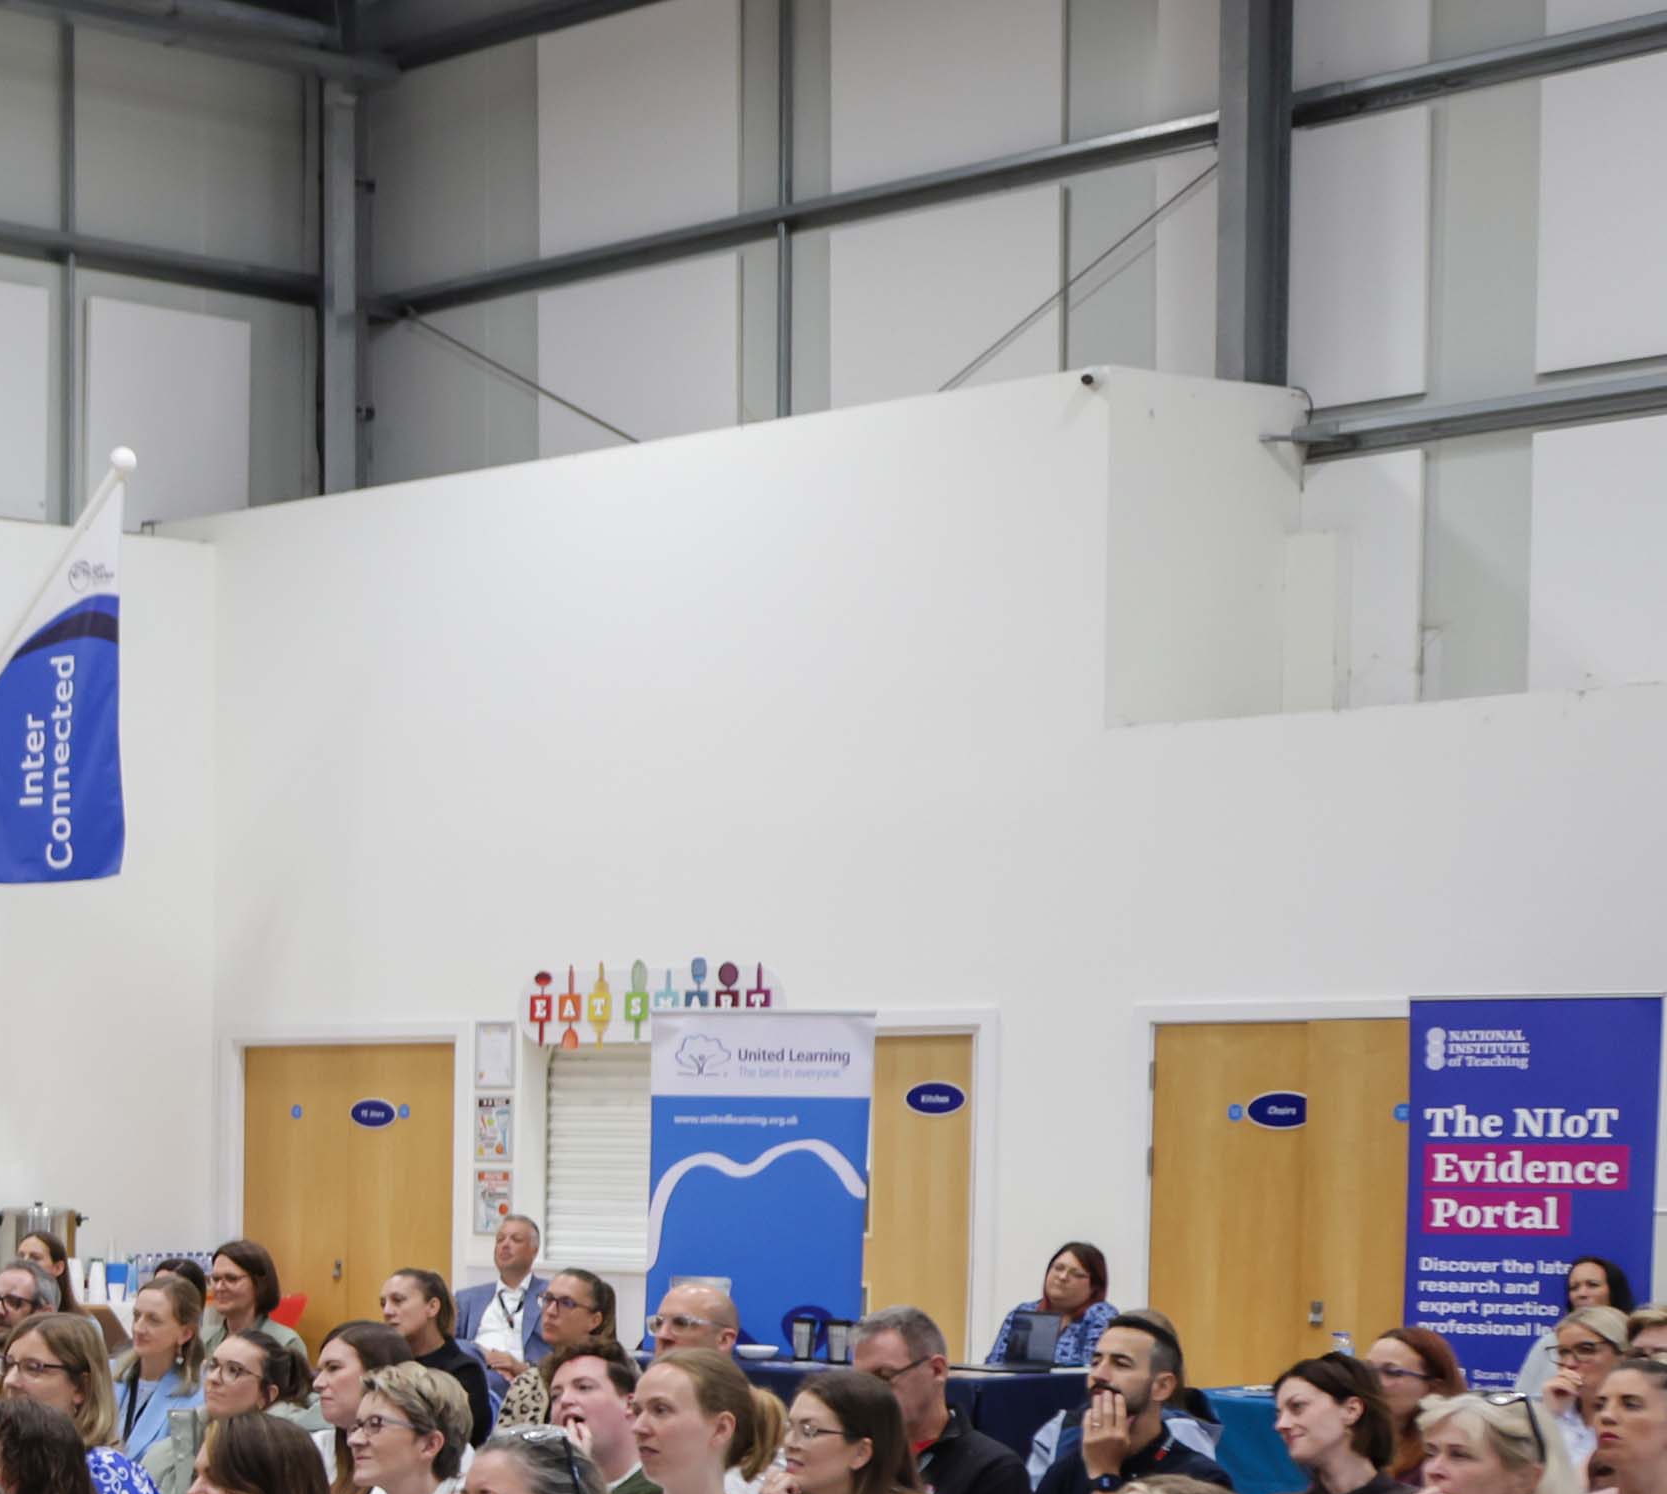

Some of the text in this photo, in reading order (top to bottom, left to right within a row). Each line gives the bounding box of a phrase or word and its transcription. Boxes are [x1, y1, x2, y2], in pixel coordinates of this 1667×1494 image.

[20, 714, 45, 806] Inter
[46, 654, 75, 870] Connected
[534, 998, 605, 1018] EAT
[1448, 1030, 1526, 1041] NATIONAL
[738, 1048, 850, 1066] United Learning
[1448, 1042, 1530, 1054] INSTITUTE
[1448, 1055, 1529, 1070] of Teaching
[1424, 1105, 1503, 1138] The
[1512, 1108, 1620, 1138] NIoT
[1432, 1151, 1620, 1184] Evidence
[1429, 1196, 1560, 1230] Portal
[1419, 1257, 1571, 1275] Discover the late
[1418, 1279, 1540, 1295] research and
[1418, 1301, 1560, 1317] expert practice
